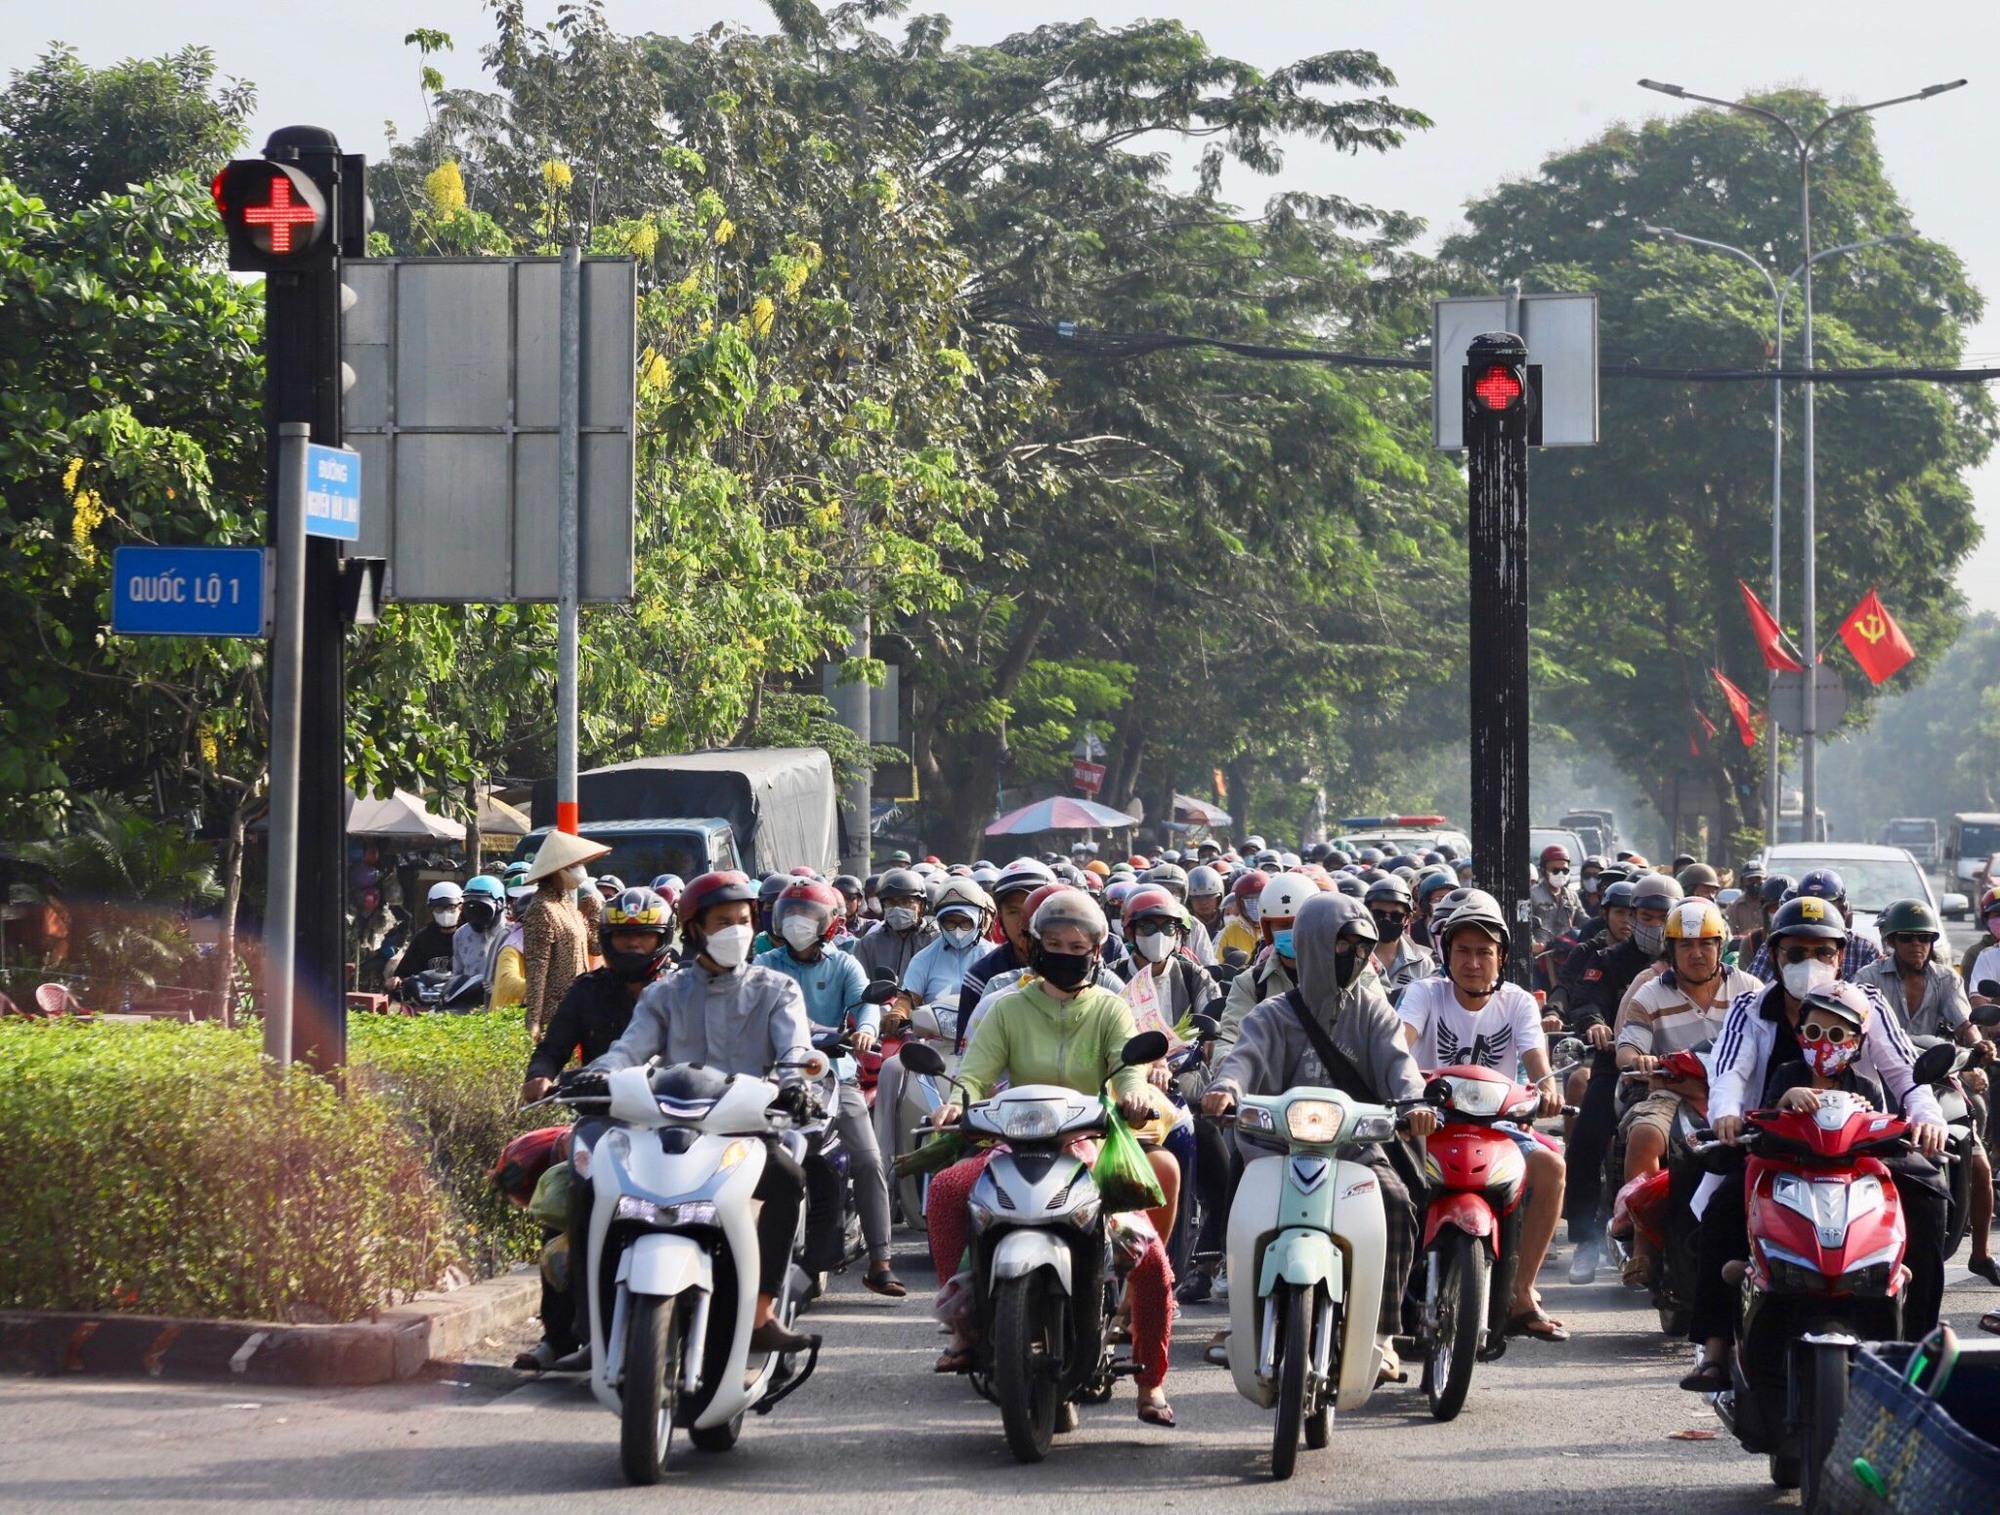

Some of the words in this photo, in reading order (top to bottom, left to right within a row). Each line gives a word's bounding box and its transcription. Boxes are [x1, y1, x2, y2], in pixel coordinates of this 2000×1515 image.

[129, 568, 186, 602] QUỐC
[194, 573, 221, 608] LỘ
[228, 578, 239, 604] 1
